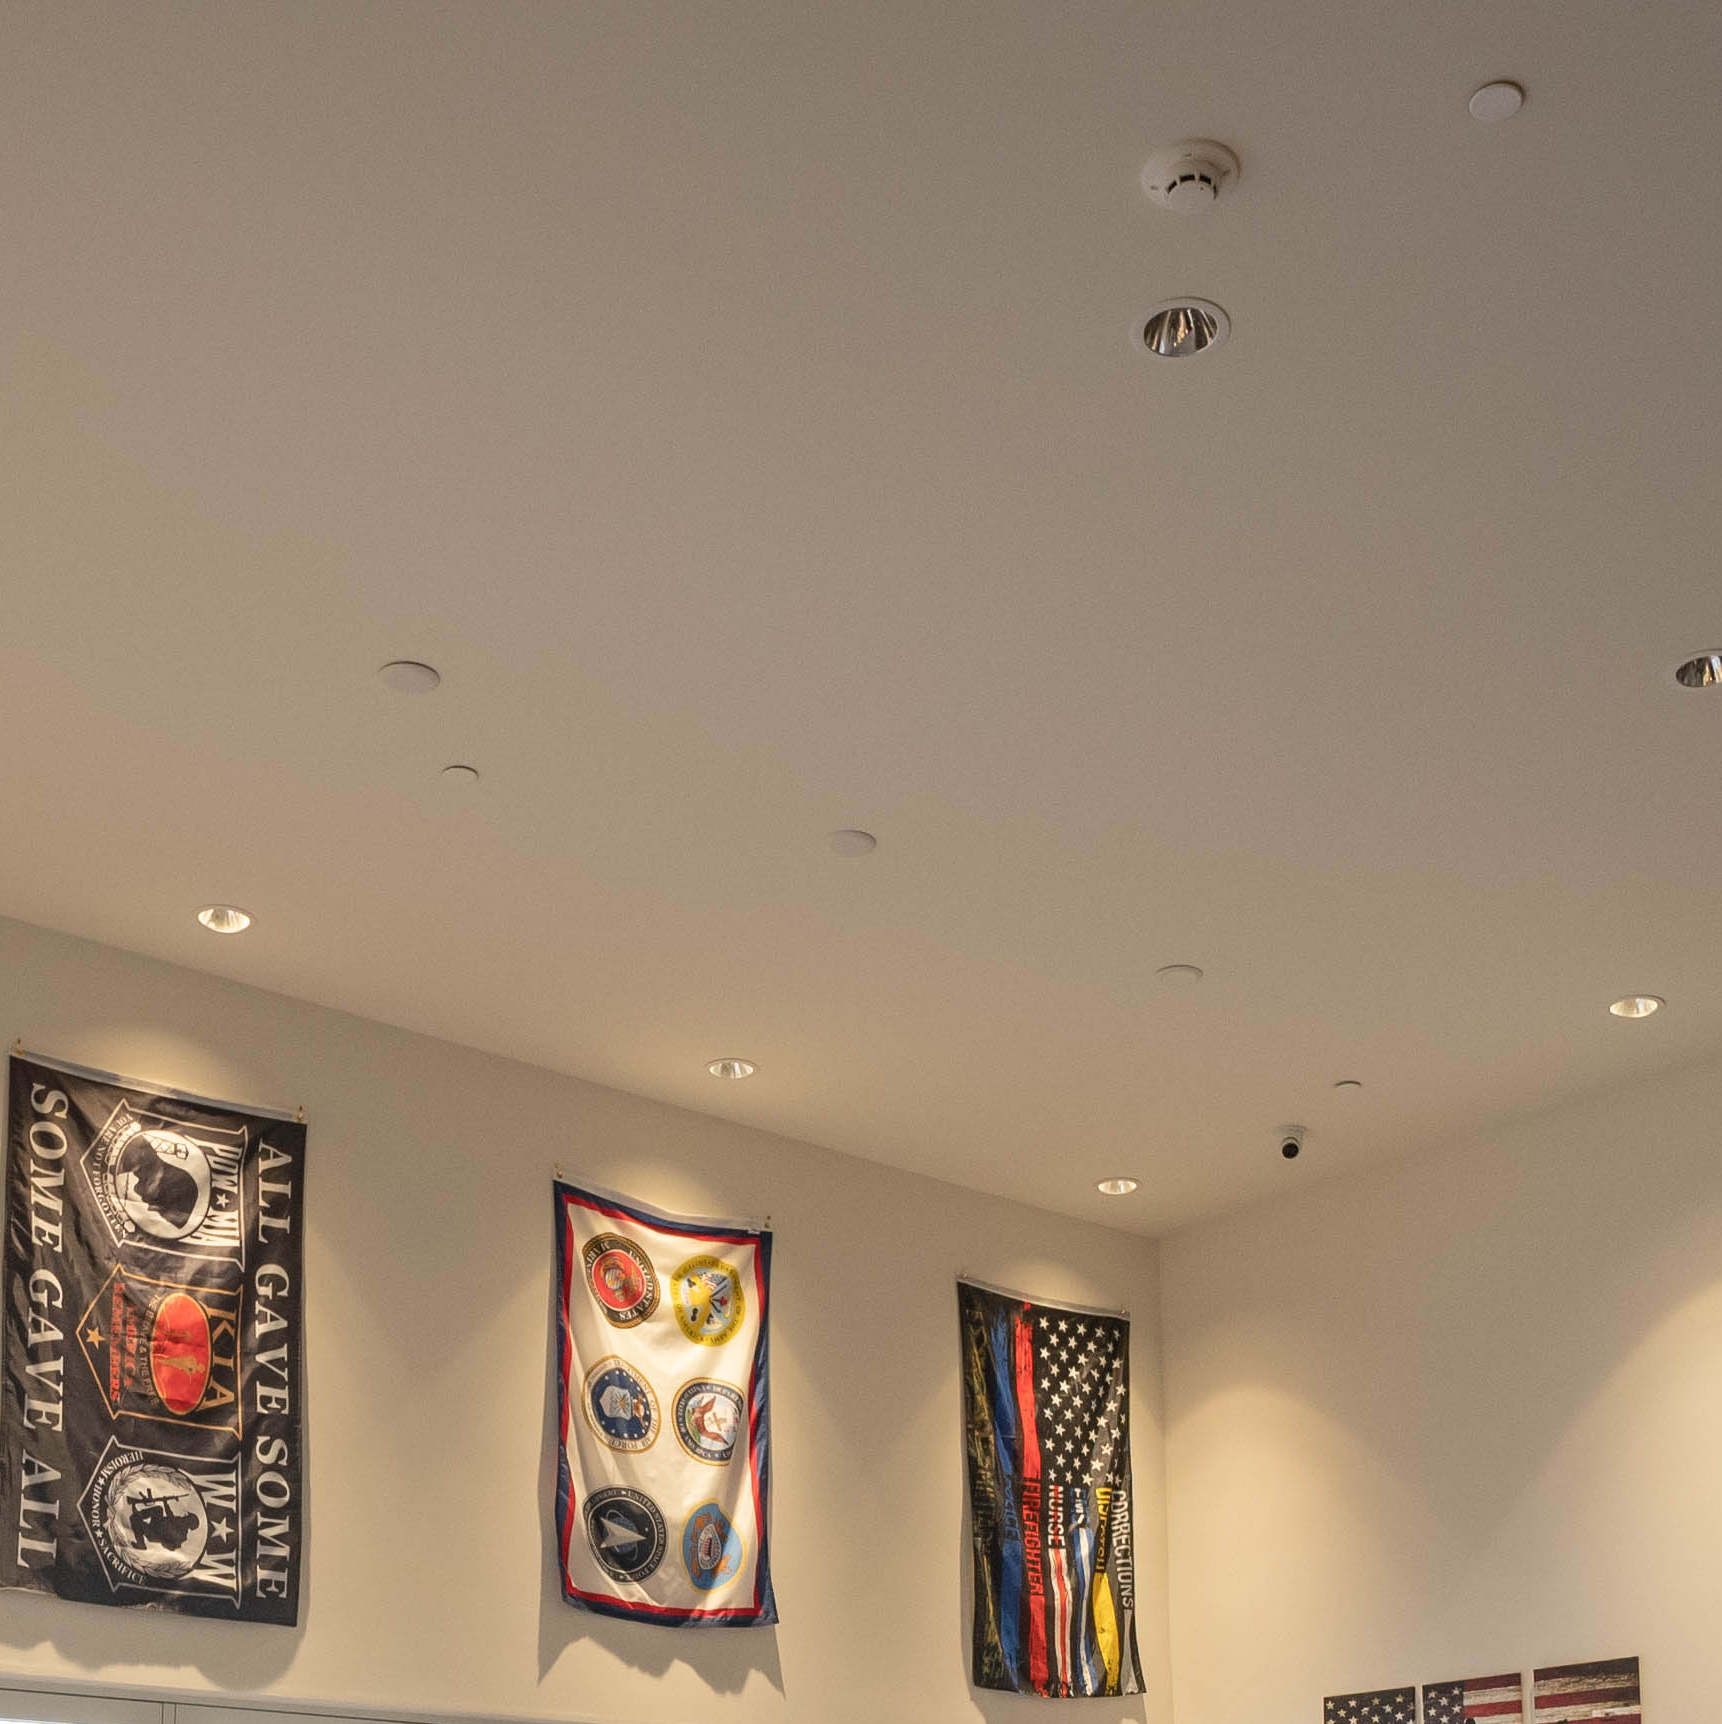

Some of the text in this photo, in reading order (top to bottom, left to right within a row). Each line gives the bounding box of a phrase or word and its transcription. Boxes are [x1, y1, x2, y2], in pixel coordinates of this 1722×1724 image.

[92, 1145, 106, 1168] NOT
[17, 1083, 69, 1568] SOME GAVE ALL
[139, 1345, 148, 1354] &
[140, 1357, 150, 1376] THE
[197, 1301, 238, 1411] KIA
[255, 1139, 292, 1599] ALL GAVE SOME
[91, 1451, 146, 1586] HEROISM HONOR SACRIFICE
[178, 1468, 238, 1591] W W
[1022, 1479, 1045, 1596] FIREFIGHTER
[1047, 1485, 1066, 1546] NURSE
[1110, 1490, 1134, 1608] CORRECTIONS
